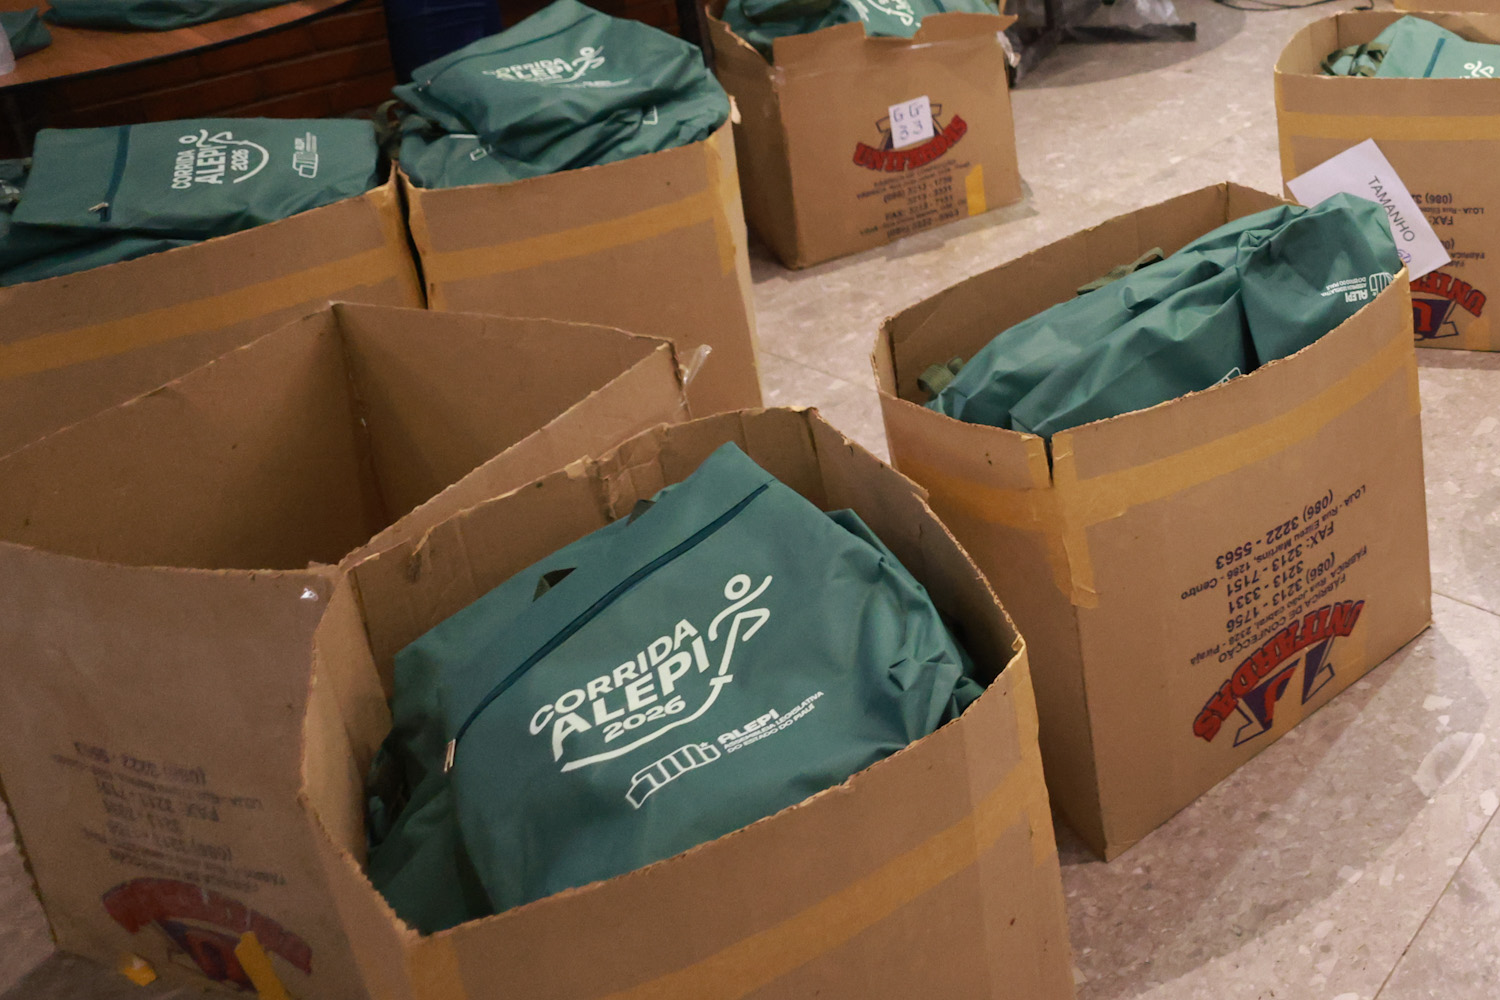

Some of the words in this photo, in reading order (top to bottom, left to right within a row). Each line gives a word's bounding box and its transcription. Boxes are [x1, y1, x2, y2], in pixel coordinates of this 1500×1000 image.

[171, 149, 196, 189] CORRIDA
[195, 145, 227, 185] ALEPI
[1367, 175, 1416, 243] TAMANHO
[1303, 489, 1333, 522] (086)
[1266, 516, 1299, 545] 3222
[1306, 520, 1335, 549] FAX:
[1216, 541, 1252, 570] 5563
[1272, 543, 1303, 572] 3213
[1306, 552, 1336, 584] (086)
[1180, 577, 1217, 600] Centro
[1227, 569, 1260, 597] 7151
[1273, 560, 1304, 588] 3213
[1228, 586, 1261, 614] 3331
[1272, 578, 1303, 607] 3213
[1226, 607, 1260, 633] 1756
[529, 618, 699, 736] CORRIDA
[1193, 600, 1366, 743] UNIFARDAS
[552, 634, 711, 762] ALEPI
[601, 695, 687, 743] 2026
[717, 708, 780, 744] ALEPI
